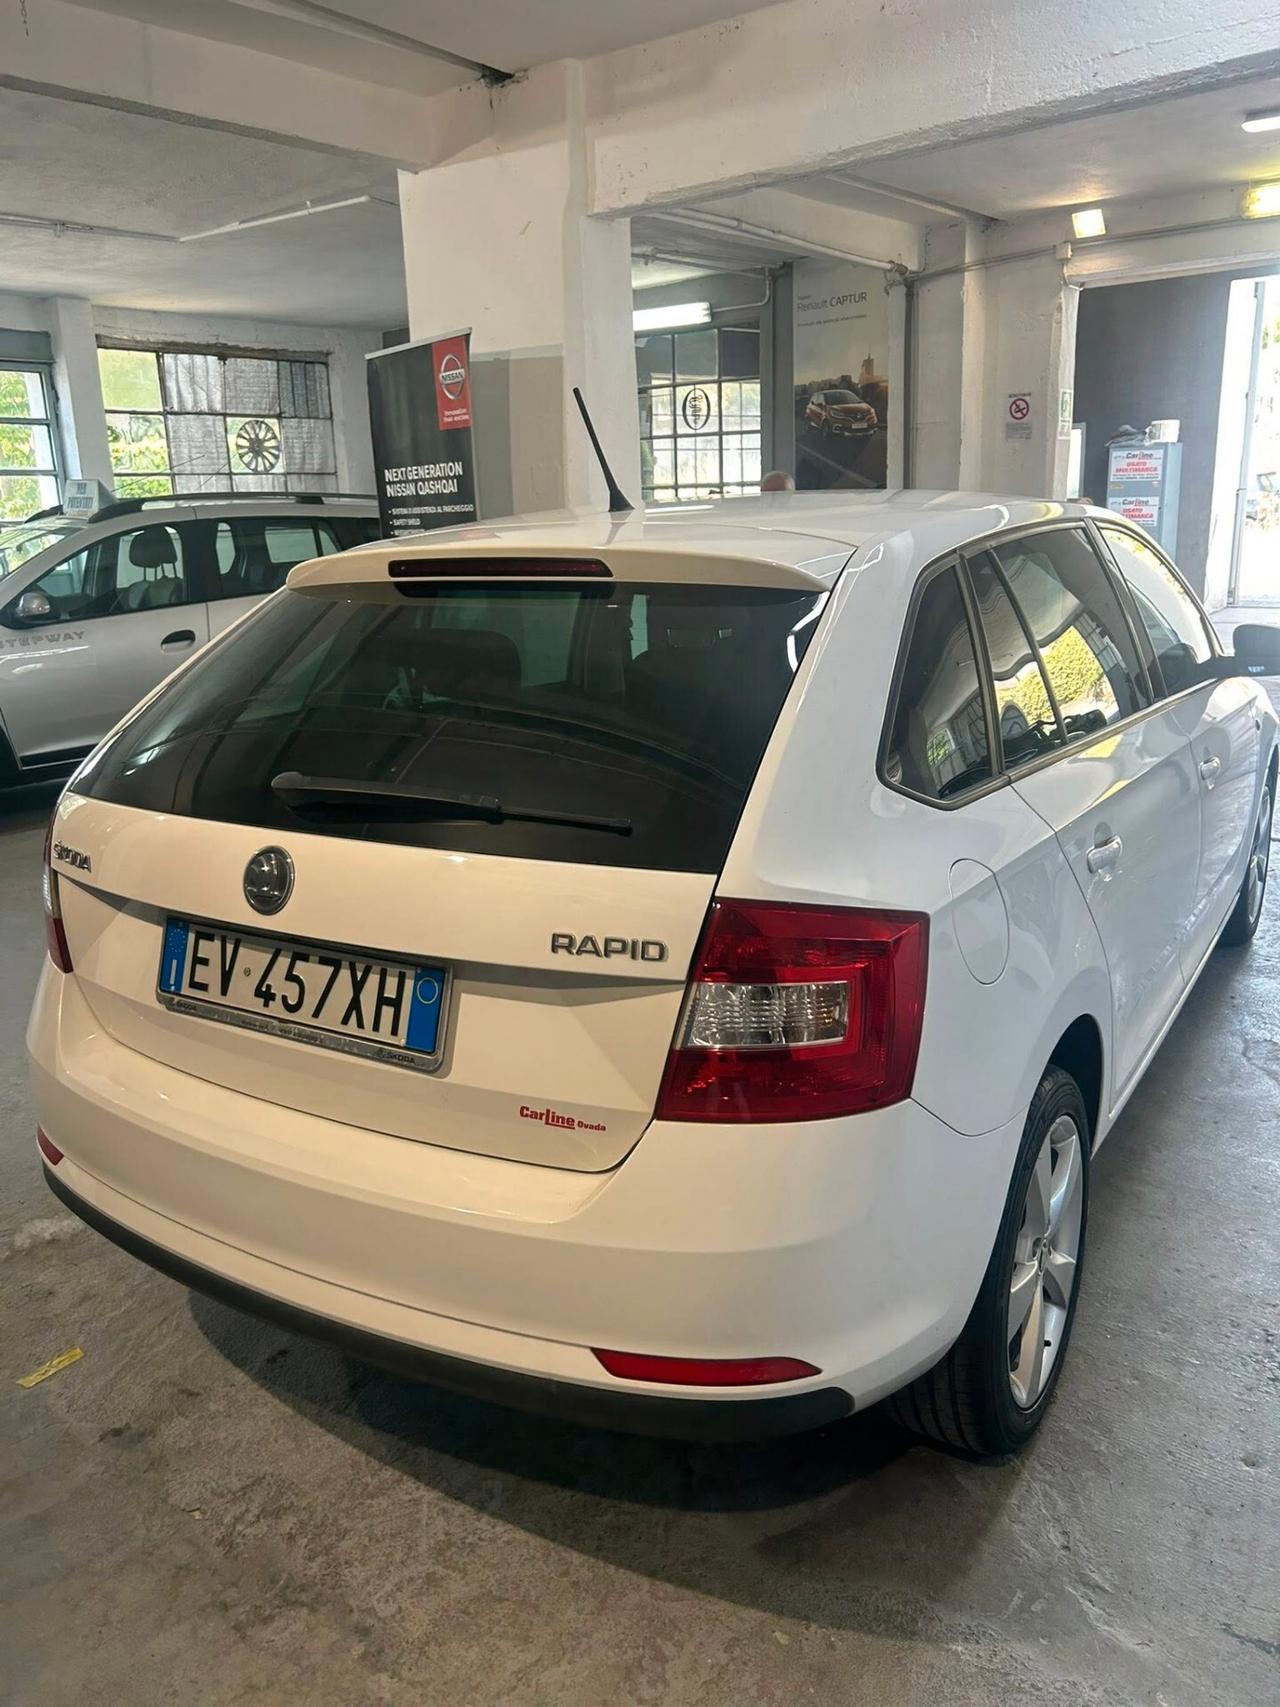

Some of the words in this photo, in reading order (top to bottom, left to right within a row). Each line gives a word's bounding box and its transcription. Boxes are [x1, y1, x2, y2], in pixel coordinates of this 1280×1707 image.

[829, 291, 868, 308] CAPTUR
[441, 370, 464, 381] NISSAN
[384, 467, 407, 482] NEXT
[406, 461, 464, 480] GENERATION
[386, 483, 416, 497] NISSAN
[417, 479, 458, 495] QASHQAI
[551, 932, 669, 962] RAPID
[188, 931, 242, 997] EV
[254, 948, 407, 1037] 457XH
[577, 1120, 607, 1132] Ovada
